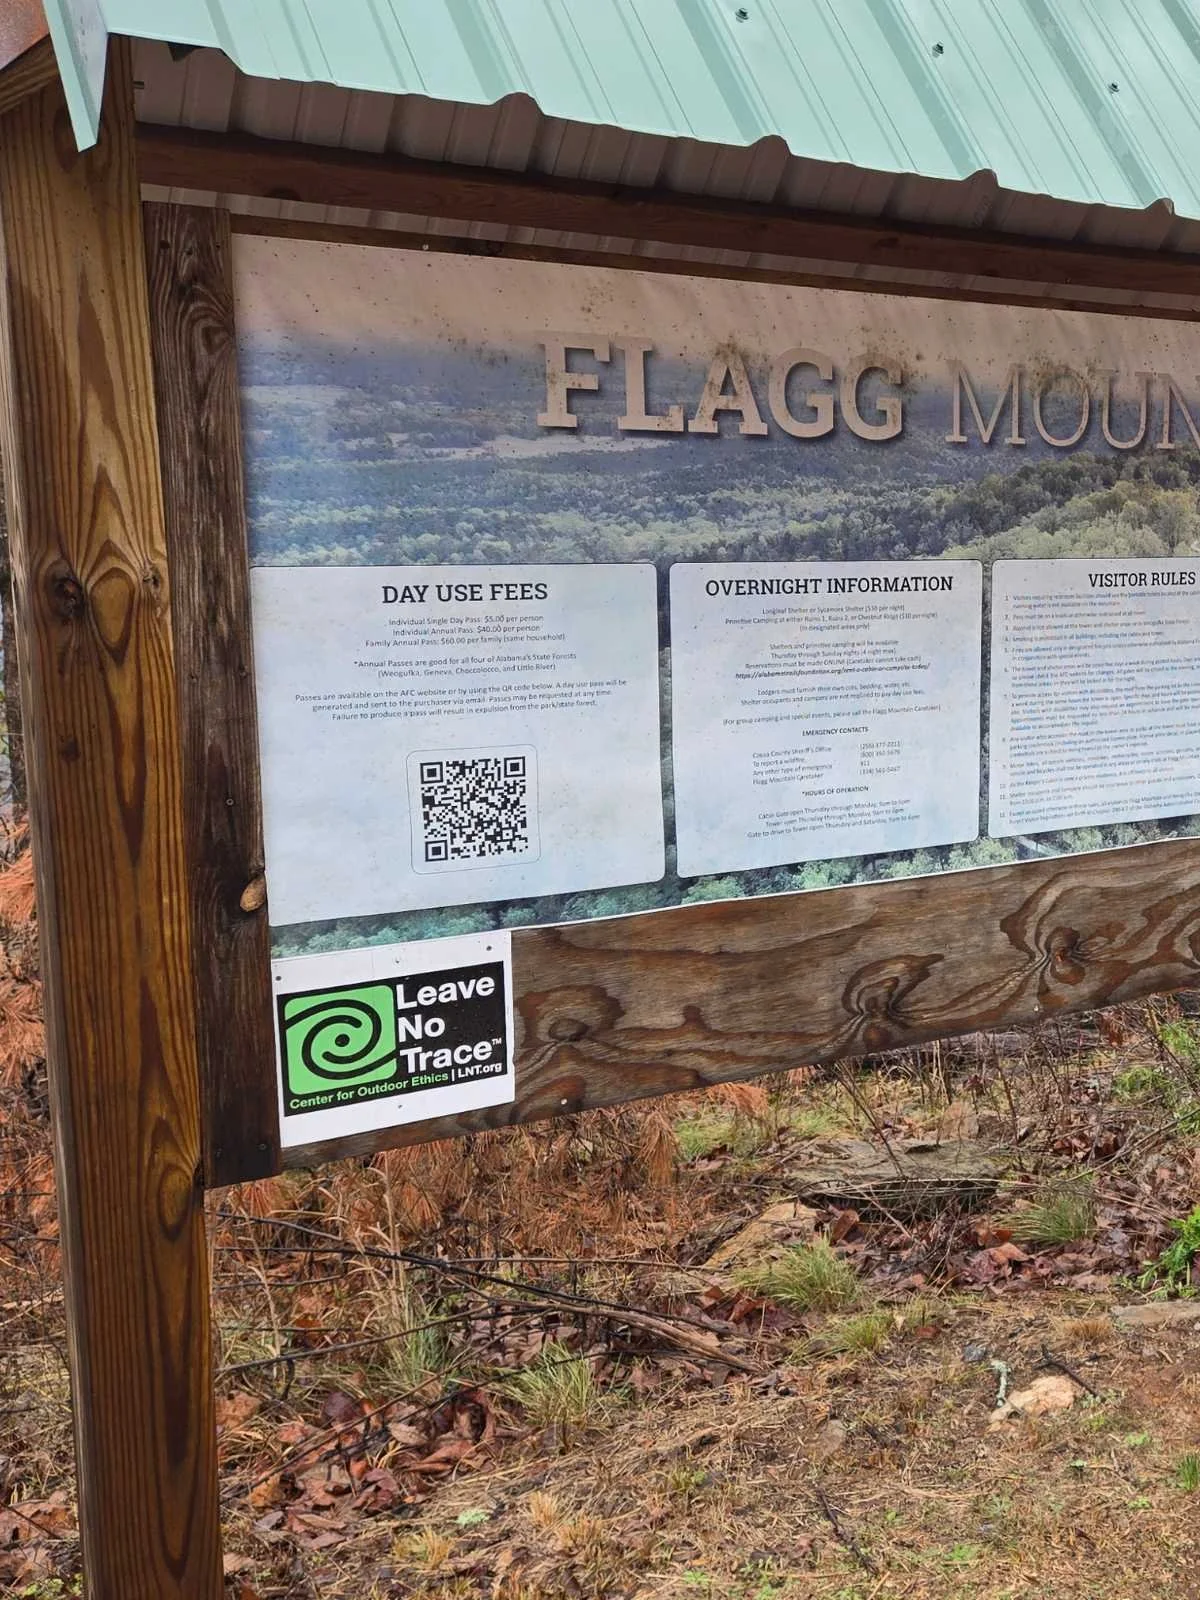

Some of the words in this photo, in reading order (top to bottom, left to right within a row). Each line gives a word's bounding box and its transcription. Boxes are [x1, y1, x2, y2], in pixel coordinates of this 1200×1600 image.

[536, 332, 905, 443] FLAGG
[705, 579, 822, 596] OVERNIGHT
[826, 576, 953, 593] INFORMATION
[1088, 574, 1147, 587] VISITOR
[1151, 572, 1196, 586] RULES
[382, 584, 429, 604] DAY
[435, 584, 484, 602] USE
[490, 583, 548, 601] FEES
[389, 617, 426, 625] Individual
[427, 617, 449, 626] Single
[450, 617, 464, 625] Day
[506, 616, 518, 624] per
[520, 615, 543, 624] person
[393, 627, 429, 636] Individual
[430, 627, 456, 635] Annual
[516, 625, 539, 634] person
[366, 638, 391, 647] Family
[392, 638, 419, 646] Annual
[481, 635, 503, 645] family
[428, 657, 447, 666] good
[448, 656, 459, 664] for
[460, 656, 469, 664] all
[533, 653, 551, 661] State
[552, 651, 576, 660] Forests
[503, 664, 516, 672] and
[803, 727, 839, 736] EMERGENCY
[839, 725, 868, 734] CONTACTS
[836, 784, 868, 794] OPERATION
[396, 976, 495, 1010] Leave
[398, 1014, 446, 1042] No
[289, 1093, 334, 1110] Center
[336, 1089, 355, 1102] for
[357, 1080, 409, 1098] Outdoor
[411, 1072, 449, 1087] Ethics
[457, 1061, 503, 1080] LNT.org
